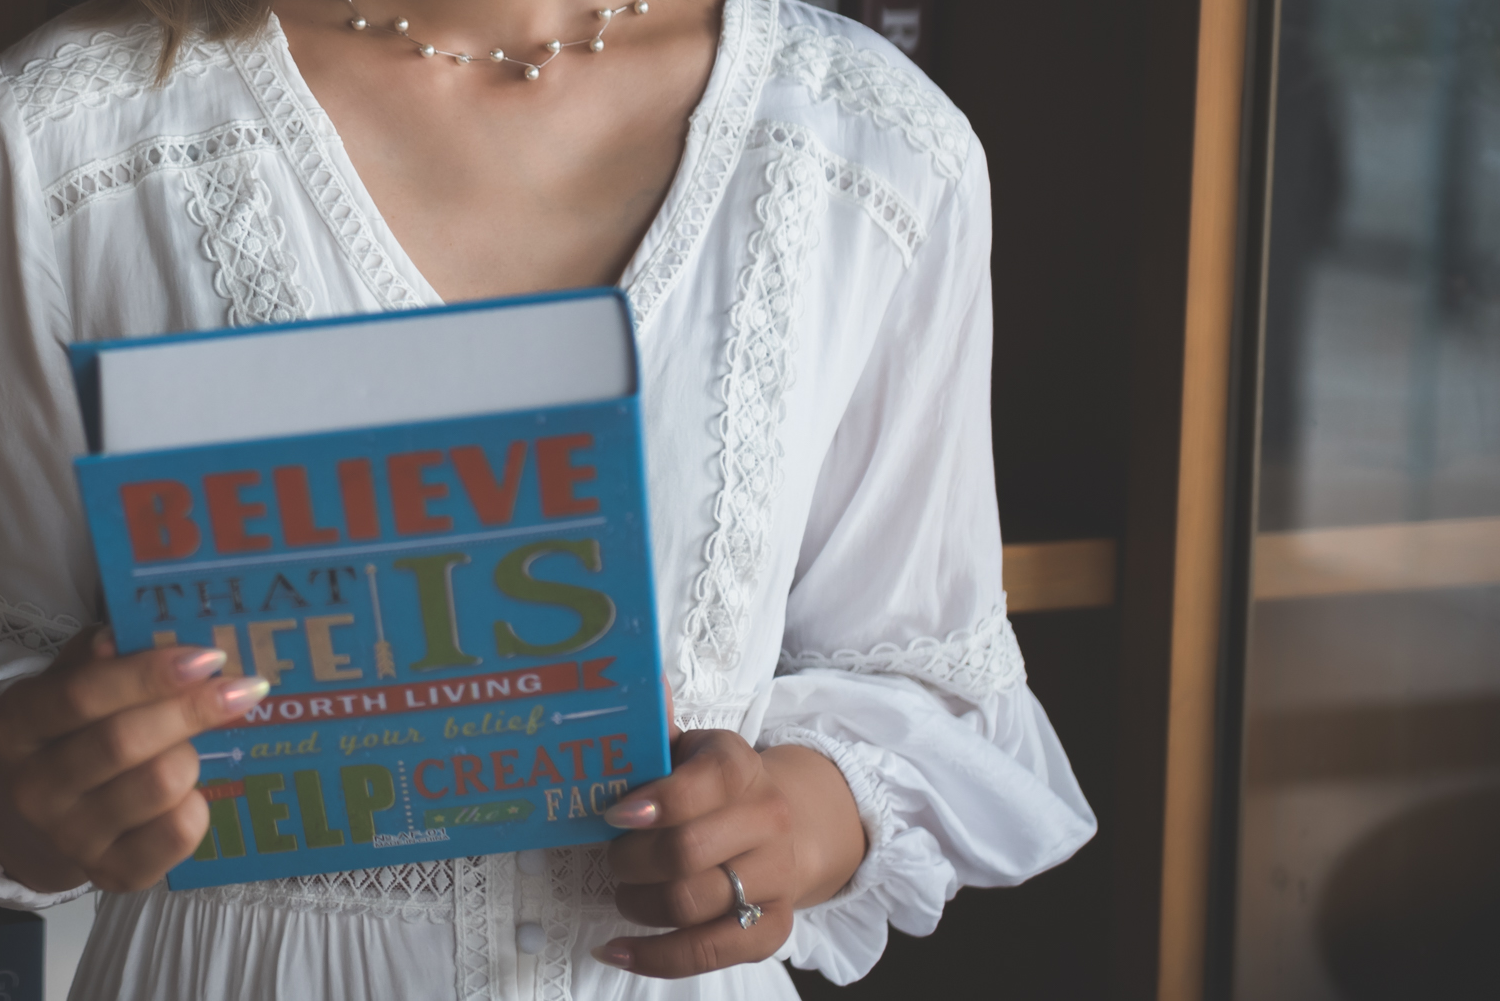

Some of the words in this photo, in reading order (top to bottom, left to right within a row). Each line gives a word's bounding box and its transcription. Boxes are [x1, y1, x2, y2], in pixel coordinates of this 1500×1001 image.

[119, 433, 599, 563] BELIEVE
[135, 565, 357, 623] THAT
[393, 539, 616, 671] IS
[154, 614, 363, 686] IFE
[243, 695, 387, 723] WORTH
[406, 673, 542, 708] LIVING
[250, 731, 321, 758] and
[340, 727, 426, 755] your
[444, 705, 546, 739] belief
[413, 733, 633, 799] CREATE
[194, 764, 396, 861] HELP
[453, 804, 499, 825] the
